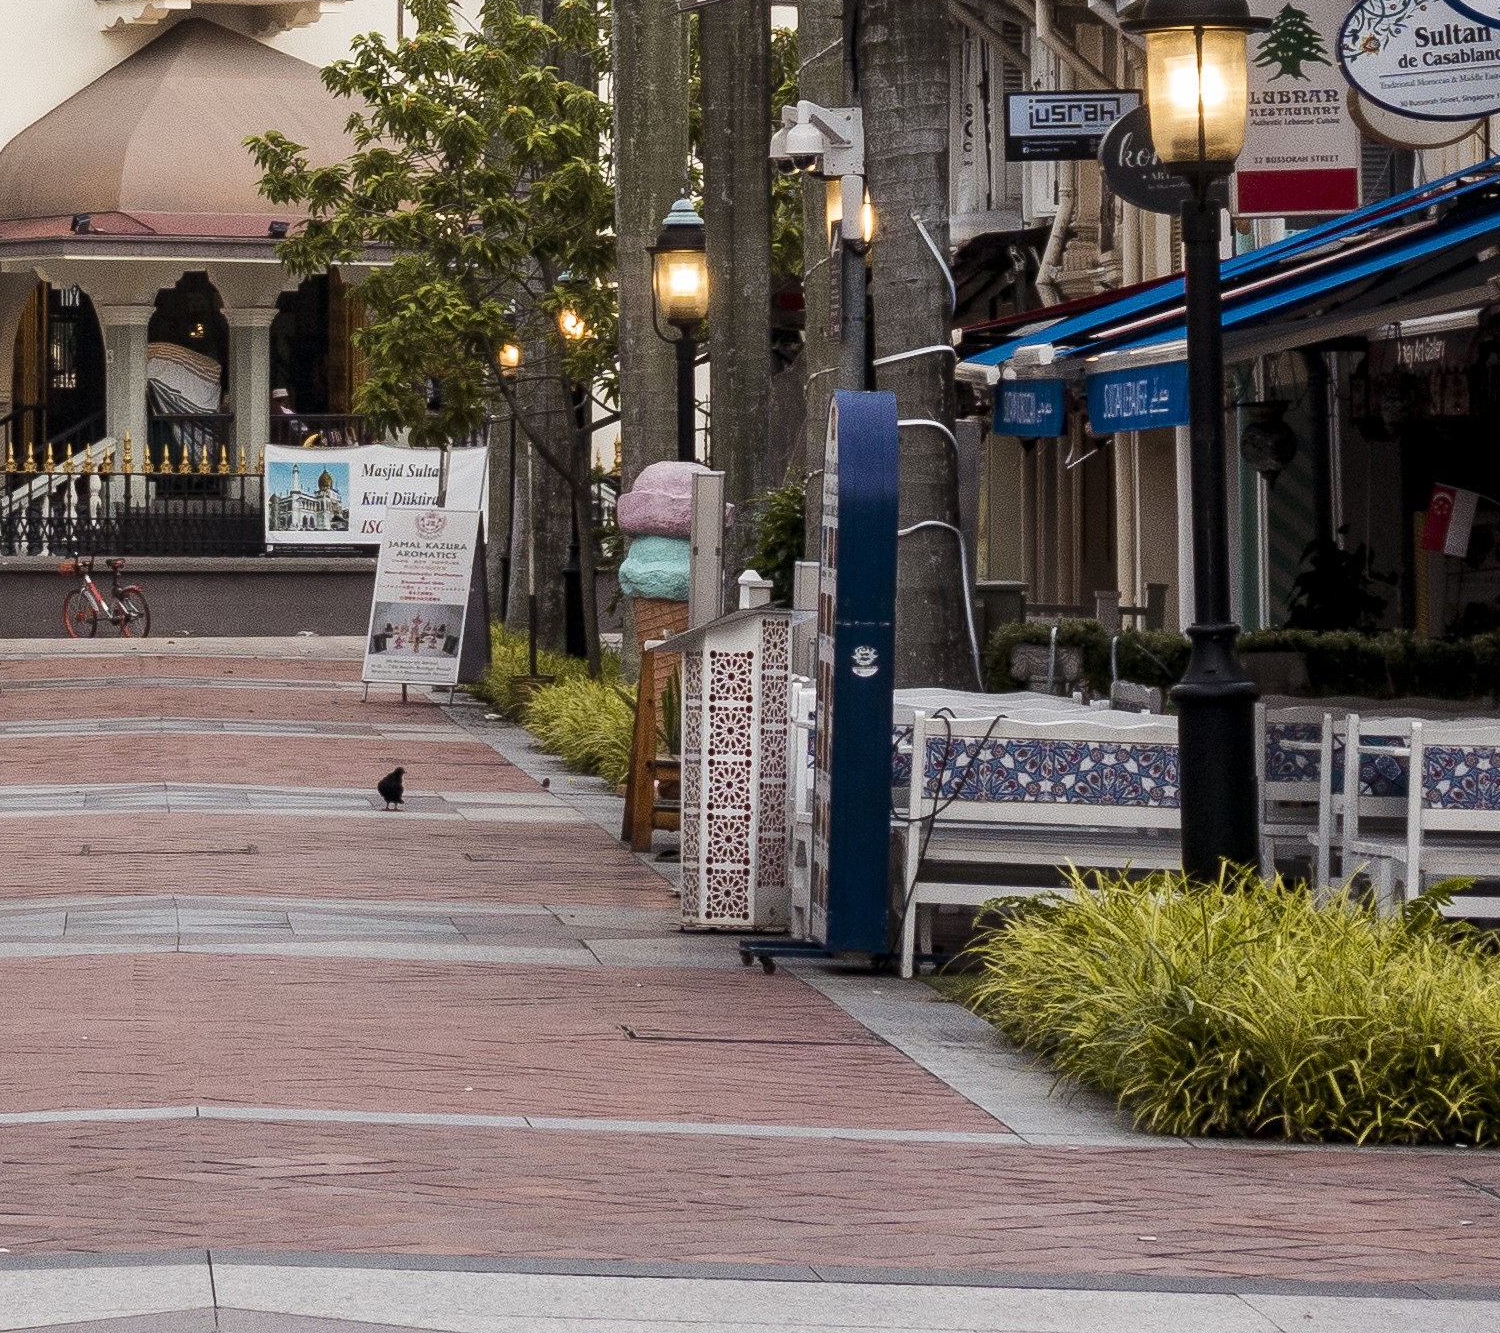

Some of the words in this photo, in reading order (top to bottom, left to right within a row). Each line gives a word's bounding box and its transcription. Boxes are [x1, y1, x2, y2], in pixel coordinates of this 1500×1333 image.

[1414, 24, 1492, 48] Sultan
[1398, 51, 1418, 69] de
[1379, 79, 1415, 90] Traditional
[1417, 77, 1450, 86] Moroccan
[1459, 74, 1484, 83] Middle
[1249, 89, 1340, 105] LUBNAN
[1461, 93, 1495, 103] Singapore
[1249, 106, 1341, 117] RESTAURANT
[1284, 117, 1315, 126] Lebanese
[1316, 117, 1341, 125] Cuisine
[1265, 155, 1309, 164] BUSSORAH
[1310, 154, 1339, 163] STREET
[361, 463, 404, 481] Masjid
[406, 463, 439, 478] Sulta
[361, 492, 387, 506] Kini
[391, 492, 439, 507] Diiktira
[388, 540, 421, 549] JAMAL
[425, 542, 468, 551] KAZURA
[396, 550, 457, 560] AROMATICS
